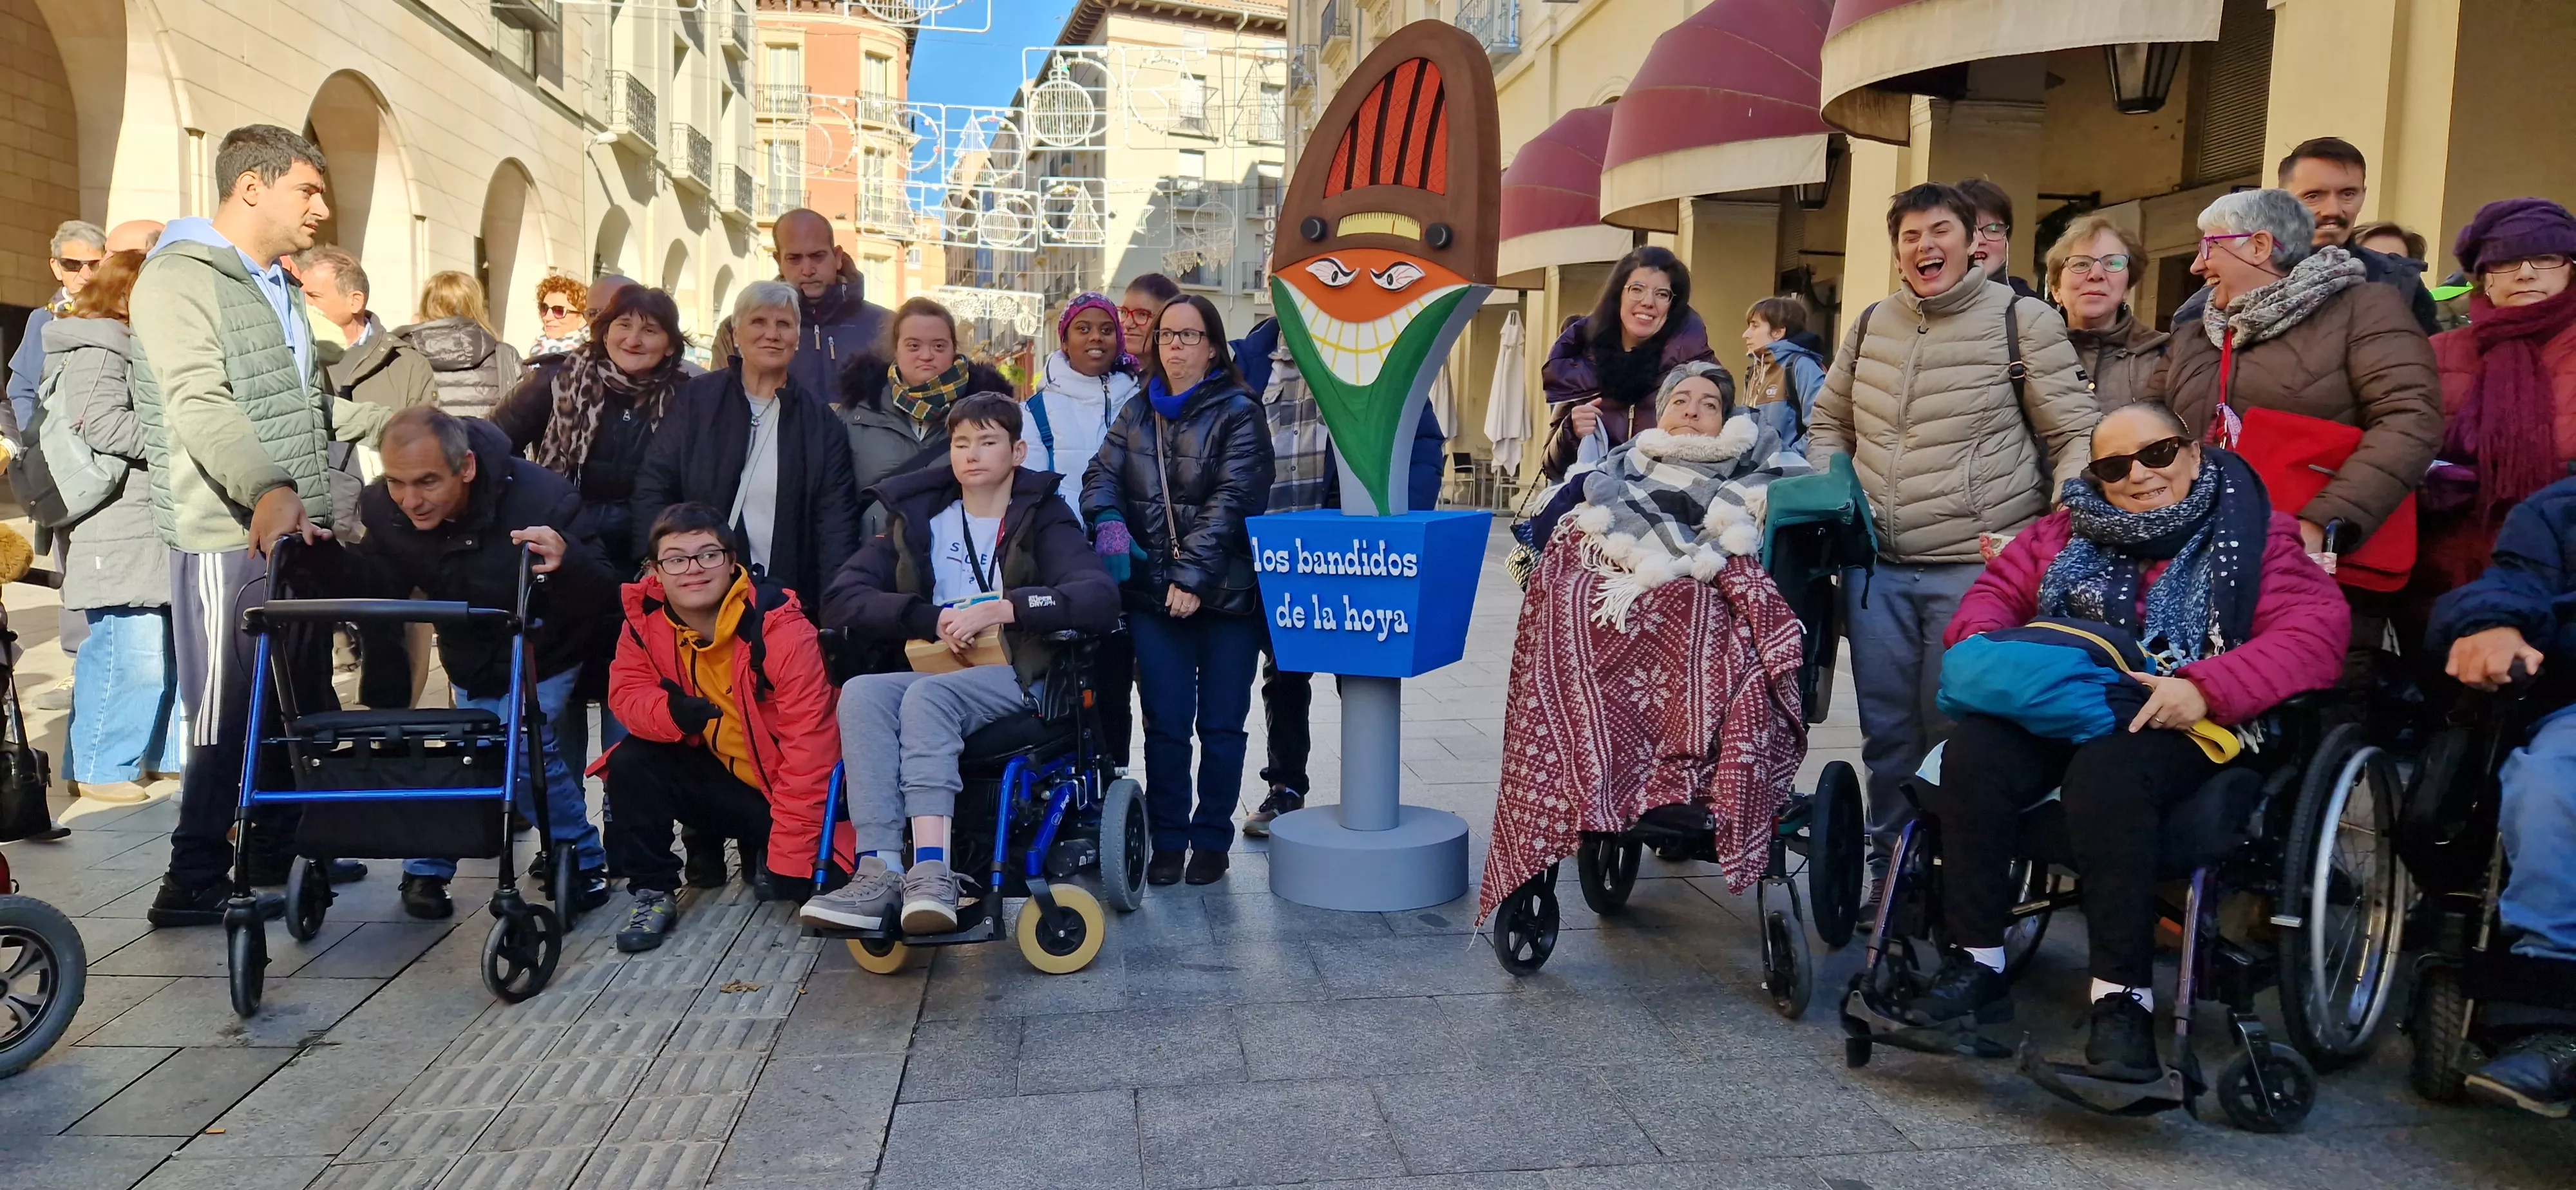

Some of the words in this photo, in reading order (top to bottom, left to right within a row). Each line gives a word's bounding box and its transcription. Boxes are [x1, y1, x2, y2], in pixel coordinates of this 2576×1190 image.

[1252, 536, 1290, 572] los
[1295, 538, 1417, 577] bandidos
[1276, 592, 1305, 628] de
[1312, 594, 1337, 630] la
[1343, 594, 1408, 642] hoya
